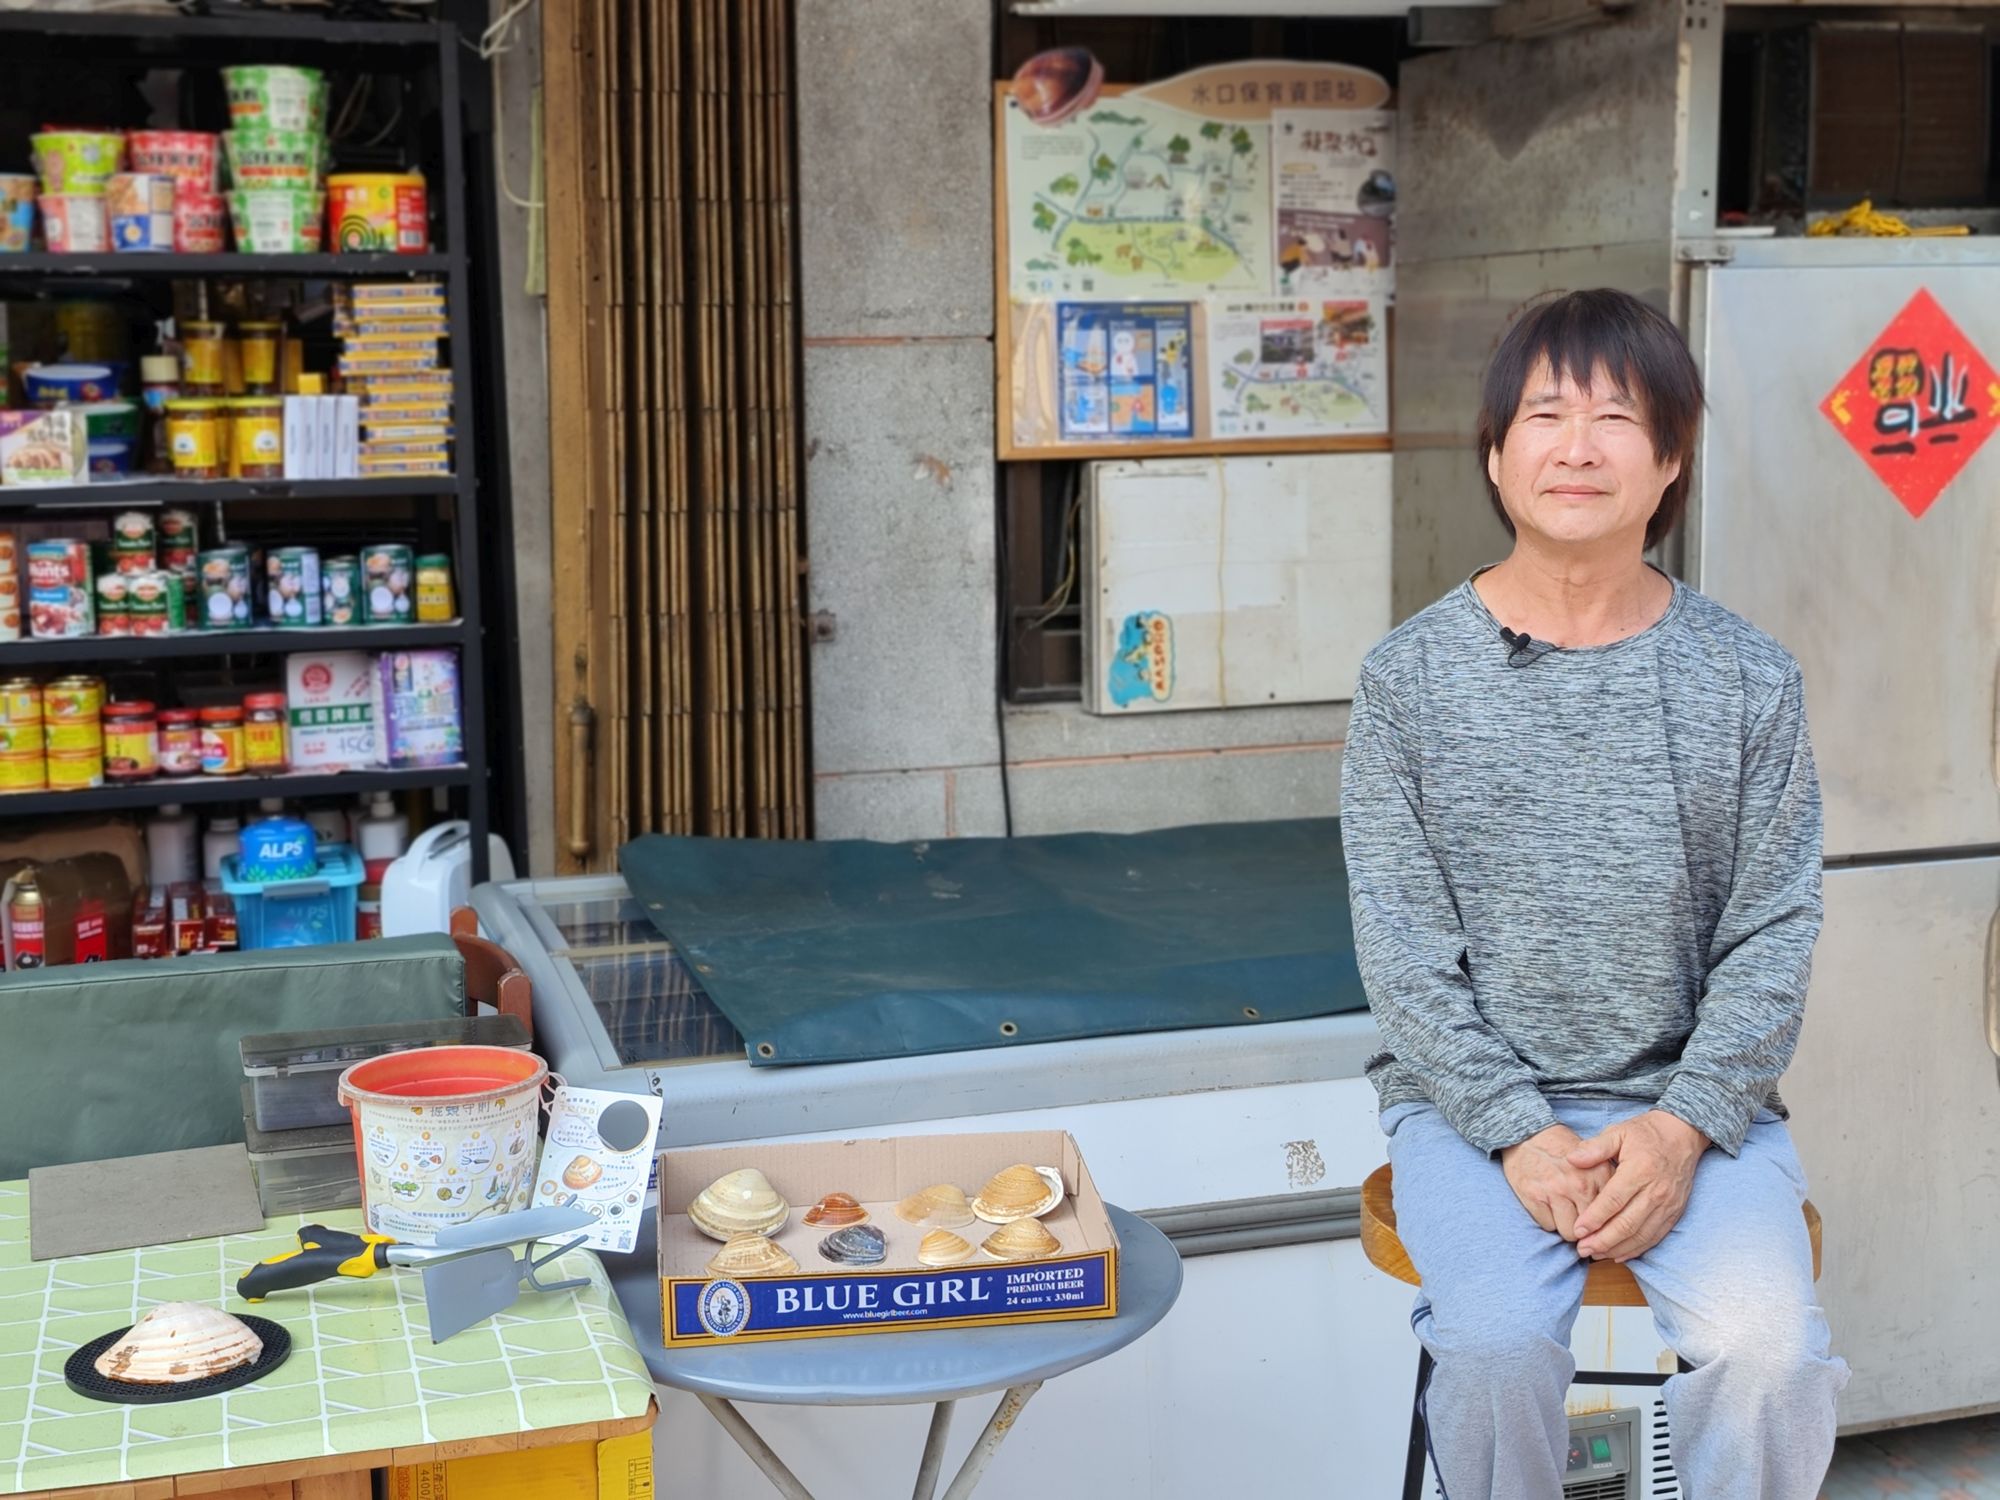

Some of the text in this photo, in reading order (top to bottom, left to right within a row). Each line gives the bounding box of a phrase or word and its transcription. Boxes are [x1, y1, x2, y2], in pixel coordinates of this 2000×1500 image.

[259, 841, 303, 858] ALPS
[1007, 1267, 1084, 1285] IMPORTED
[1006, 1279, 1084, 1294] PREMIUM BEER
[776, 1278, 989, 1314] BLUE GIRL
[1006, 1297, 1018, 1305] 24
[1020, 1296, 1043, 1304] cans
[1055, 1291, 1084, 1302] 330ml
[843, 1307, 928, 1321] www.bluegirlbeer.com
